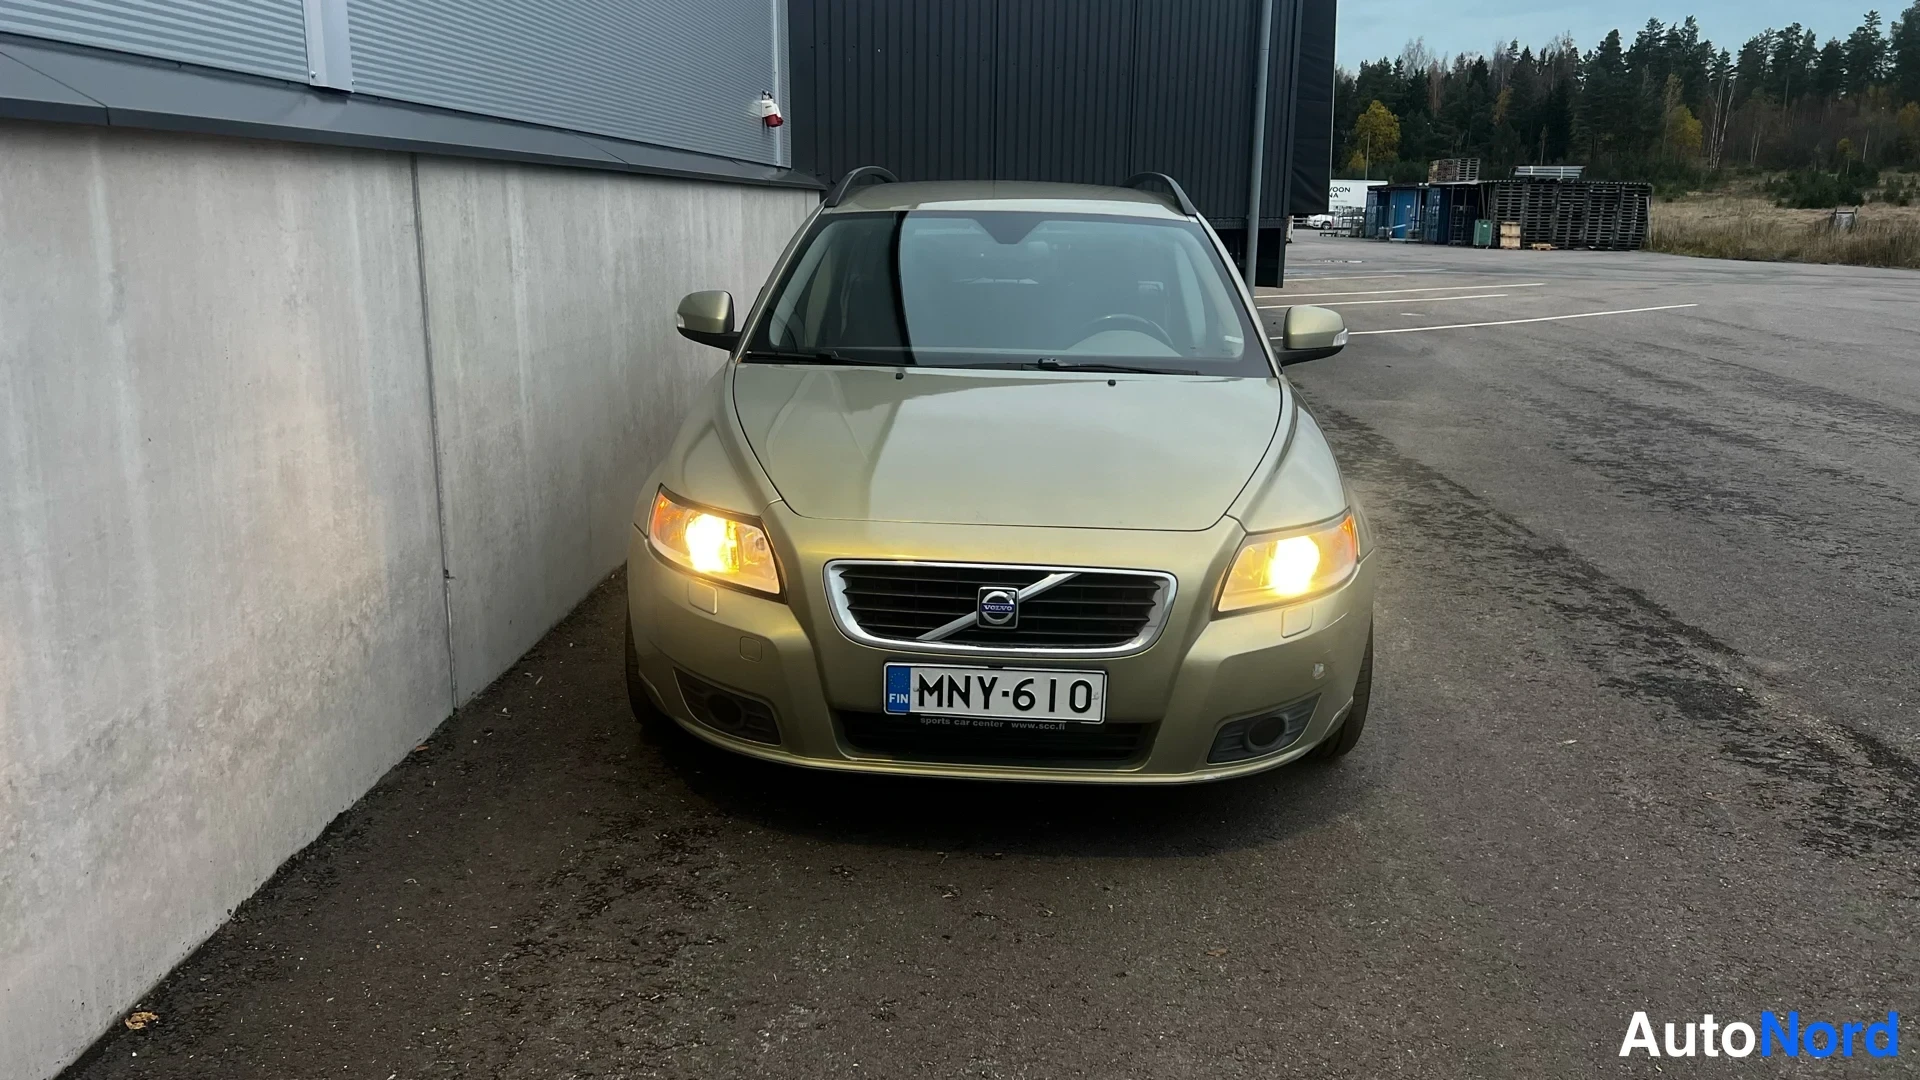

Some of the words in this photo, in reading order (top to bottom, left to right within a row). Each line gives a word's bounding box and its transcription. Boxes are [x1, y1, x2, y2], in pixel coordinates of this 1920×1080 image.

[889, 693, 909, 704] FIN
[918, 673, 1093, 714] MNY-610
[920, 716, 951, 725] sports
[953, 718, 971, 726] car
[972, 719, 1004, 728] center
[1011, 721, 1066, 731] www.scc.fi
